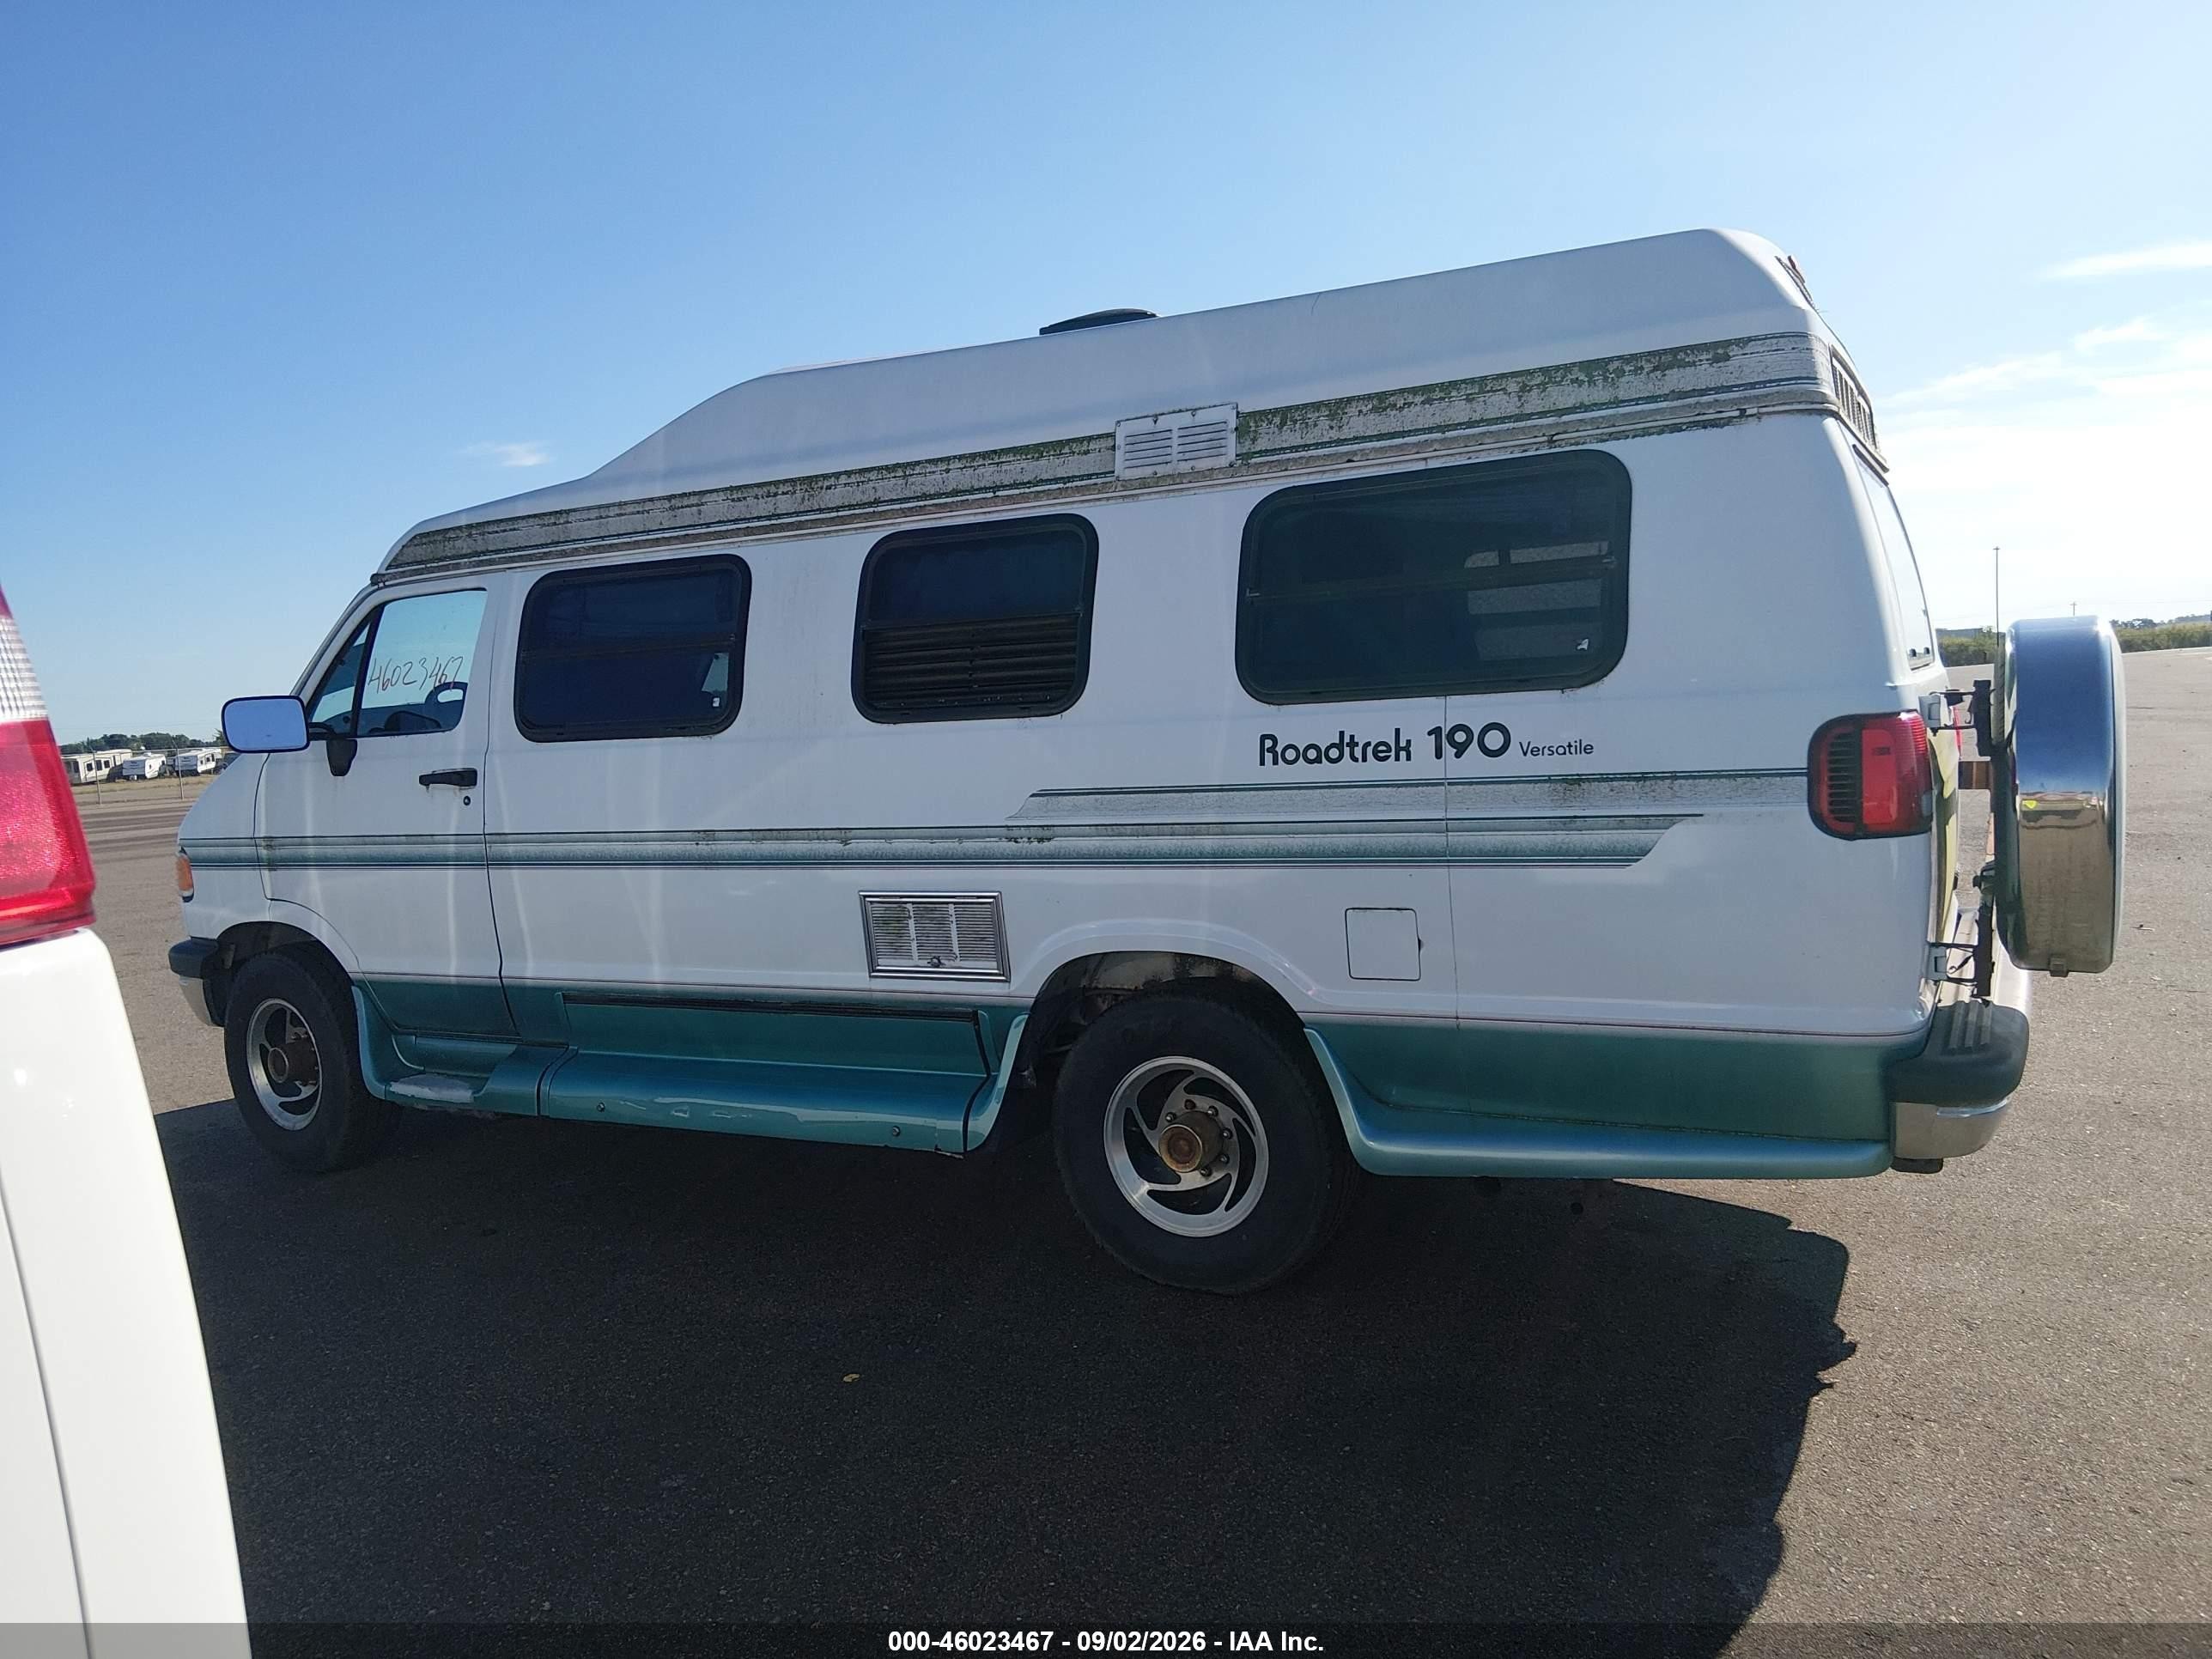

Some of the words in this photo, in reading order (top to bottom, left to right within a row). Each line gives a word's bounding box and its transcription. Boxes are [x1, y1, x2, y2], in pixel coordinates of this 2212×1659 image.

[368, 656, 464, 694] 46023467
[1259, 727, 1413, 767] Roadtrek
[1426, 721, 1511, 760] 190
[1518, 738, 1595, 757] Versatile
